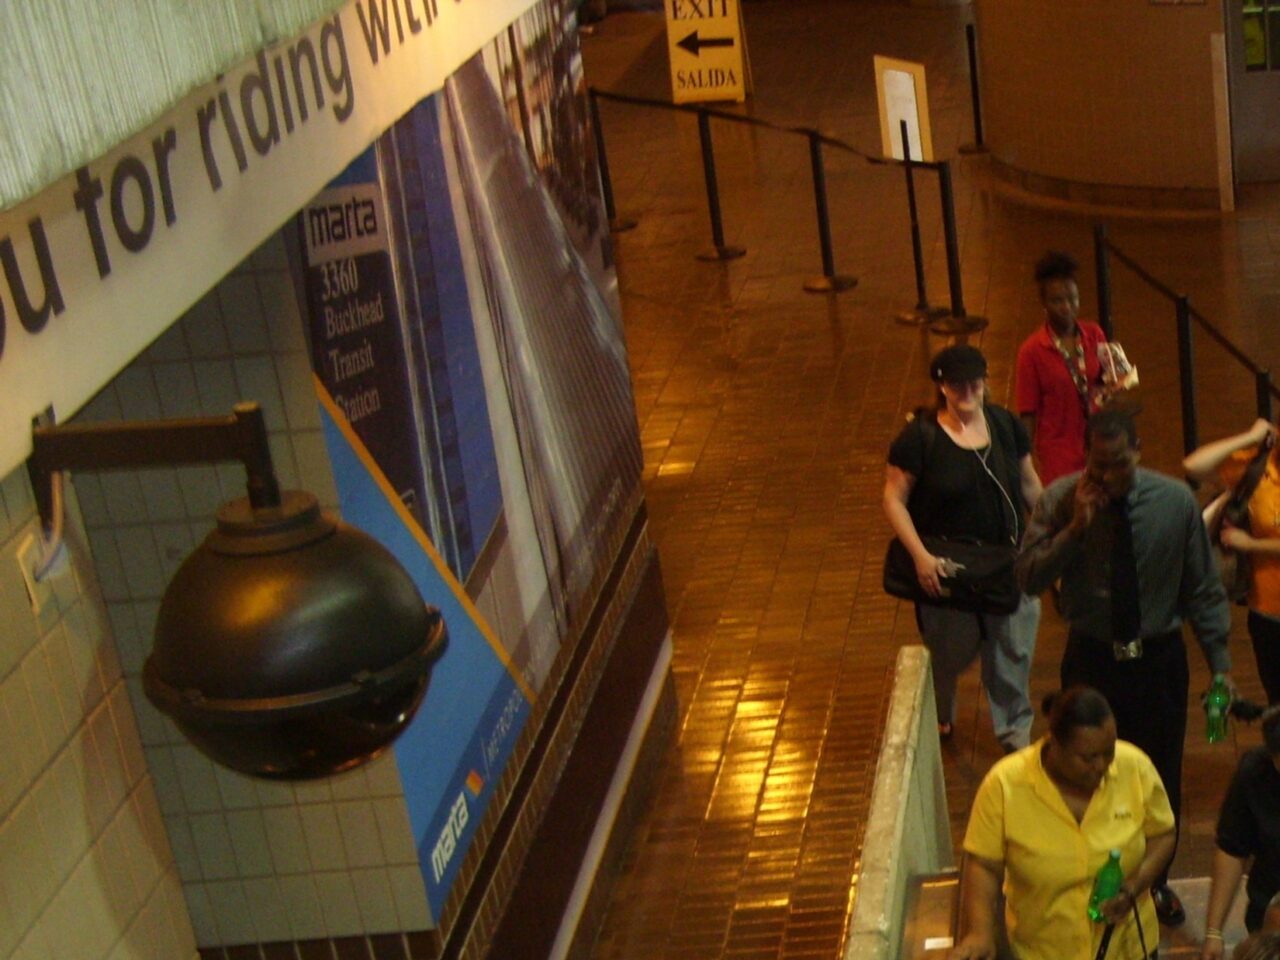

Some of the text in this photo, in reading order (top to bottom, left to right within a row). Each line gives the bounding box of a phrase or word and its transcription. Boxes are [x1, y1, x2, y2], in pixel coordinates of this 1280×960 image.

[672, 0, 729, 20] EXIT
[677, 67, 737, 88] SALIDA
[73, 127, 177, 280] for
[197, 13, 355, 194] riding
[308, 196, 378, 249] marta
[321, 257, 358, 301] 3360
[324, 292, 384, 339] Buckhead
[328, 338, 375, 383] Transit
[431, 791, 469, 885] marta
